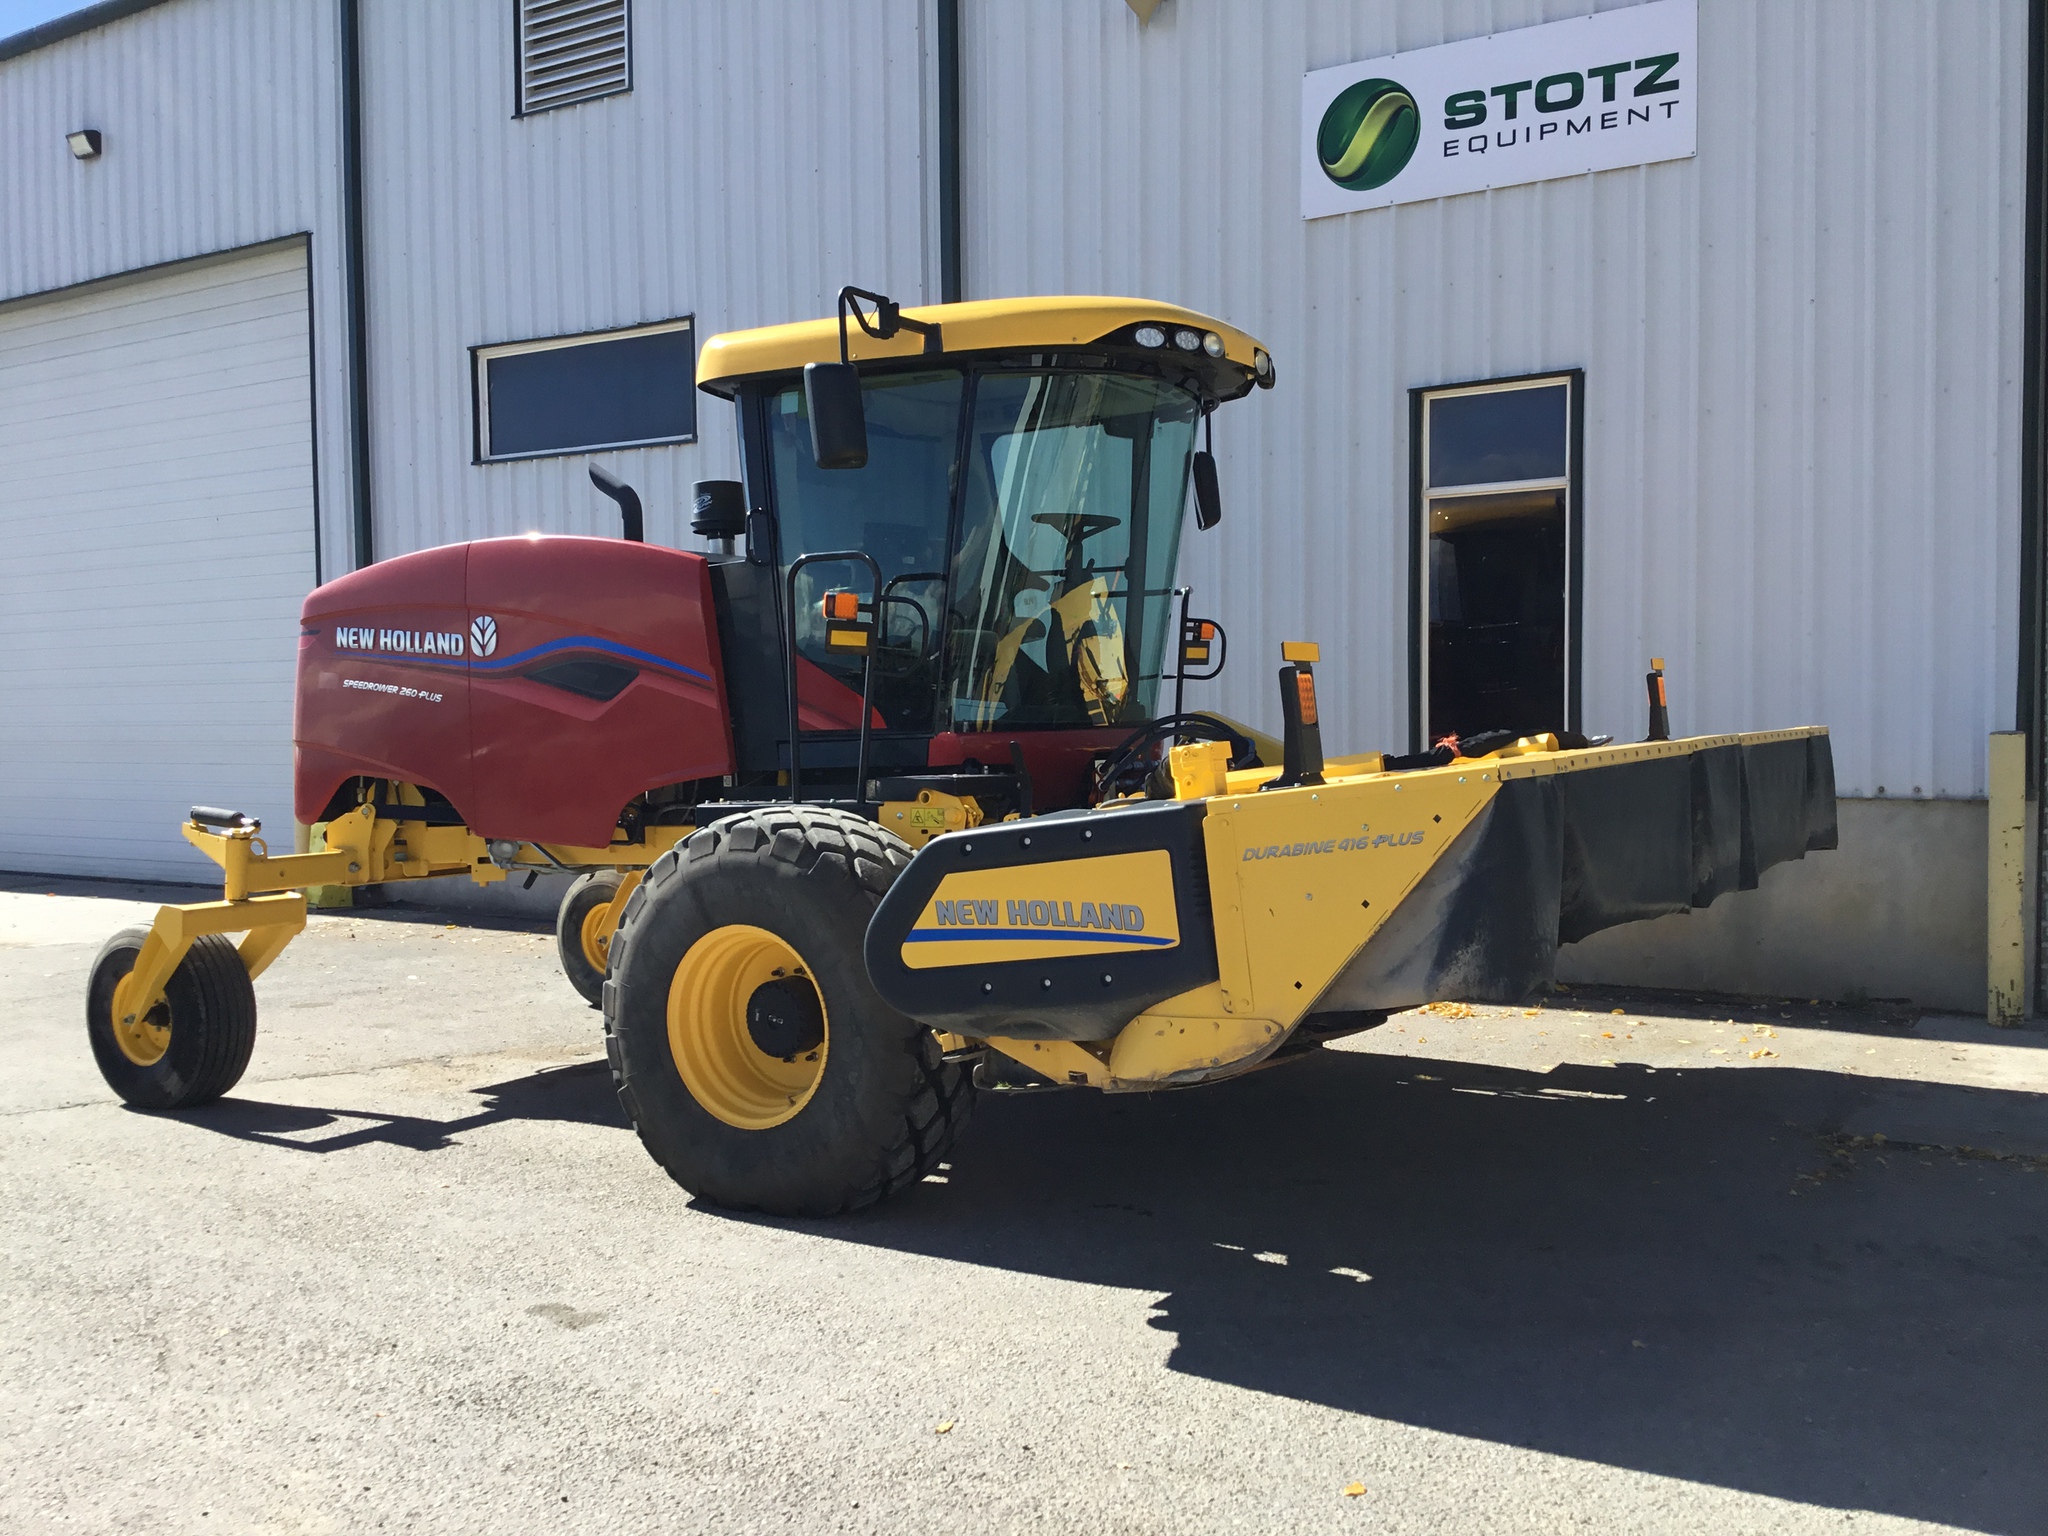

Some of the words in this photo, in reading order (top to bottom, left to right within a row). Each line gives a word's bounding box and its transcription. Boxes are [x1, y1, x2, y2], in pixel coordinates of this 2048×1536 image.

[1444, 52, 1680, 131] STOTZ
[1443, 100, 1680, 158] EQUIPMENT
[336, 626, 375, 650] NEW
[379, 629, 465, 656] HOLLAND
[342, 679, 399, 694] SPEEDROWER
[399, 687, 418, 698] 260
[1242, 839, 1336, 862] DURABINE
[1338, 835, 1370, 851] 416
[935, 900, 998, 925] NEW
[1006, 900, 1145, 932] HOLLAND
